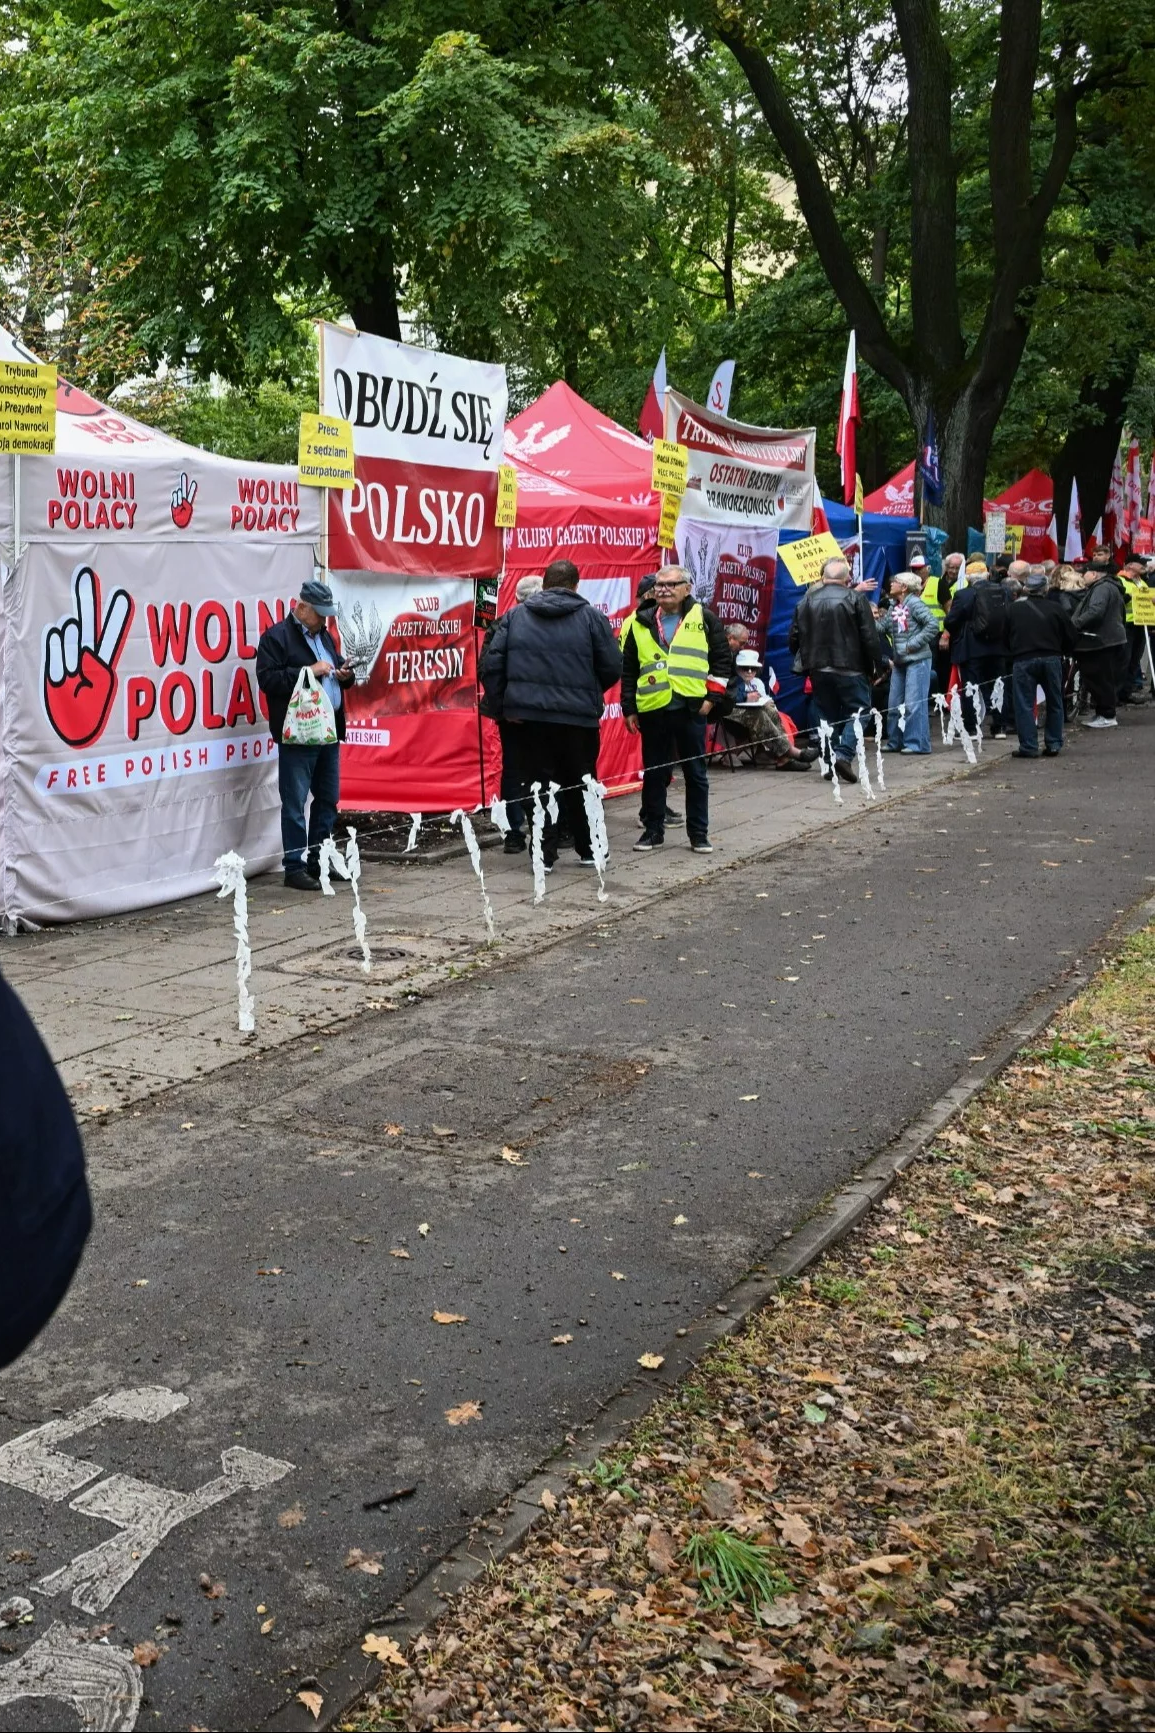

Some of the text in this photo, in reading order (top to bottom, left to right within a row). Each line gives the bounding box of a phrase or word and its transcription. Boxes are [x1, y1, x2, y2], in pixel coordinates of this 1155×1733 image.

[0, 400, 43, 416] i Prezydent
[334, 368, 494, 461] OBUDŹ SIĘ
[15, 419, 50, 433] Nawrocki
[317, 422, 339, 437] Precz
[12, 438, 54, 453] demokracji
[314, 445, 348, 459] sędziami
[57, 467, 135, 500] WOLNI
[300, 465, 353, 479] uzurpatorami
[709, 463, 782, 494] OSTATNI BASTION
[238, 478, 299, 506] WOLNI
[706, 489, 776, 518] PRAWORZĄDNOŚCI
[48, 499, 137, 530] POLACY
[230, 504, 300, 532] POLACY
[342, 477, 485, 548] POLSKO
[517, 524, 646, 550] KLUBY GAZETY POLSKIEJ
[792, 538, 820, 551] KASTA
[737, 543, 753, 559] KLUB
[718, 560, 742, 576] GAZETY
[413, 597, 440, 612] KLUB
[147, 597, 296, 668] WOLN
[390, 619, 462, 638] GAZETY POLSKIEJ
[385, 647, 466, 684] TERESIN
[127, 665, 270, 741] POLA
[345, 731, 382, 744] ATELSKIE
[47, 738, 275, 789] FREE POLISH PEOP
